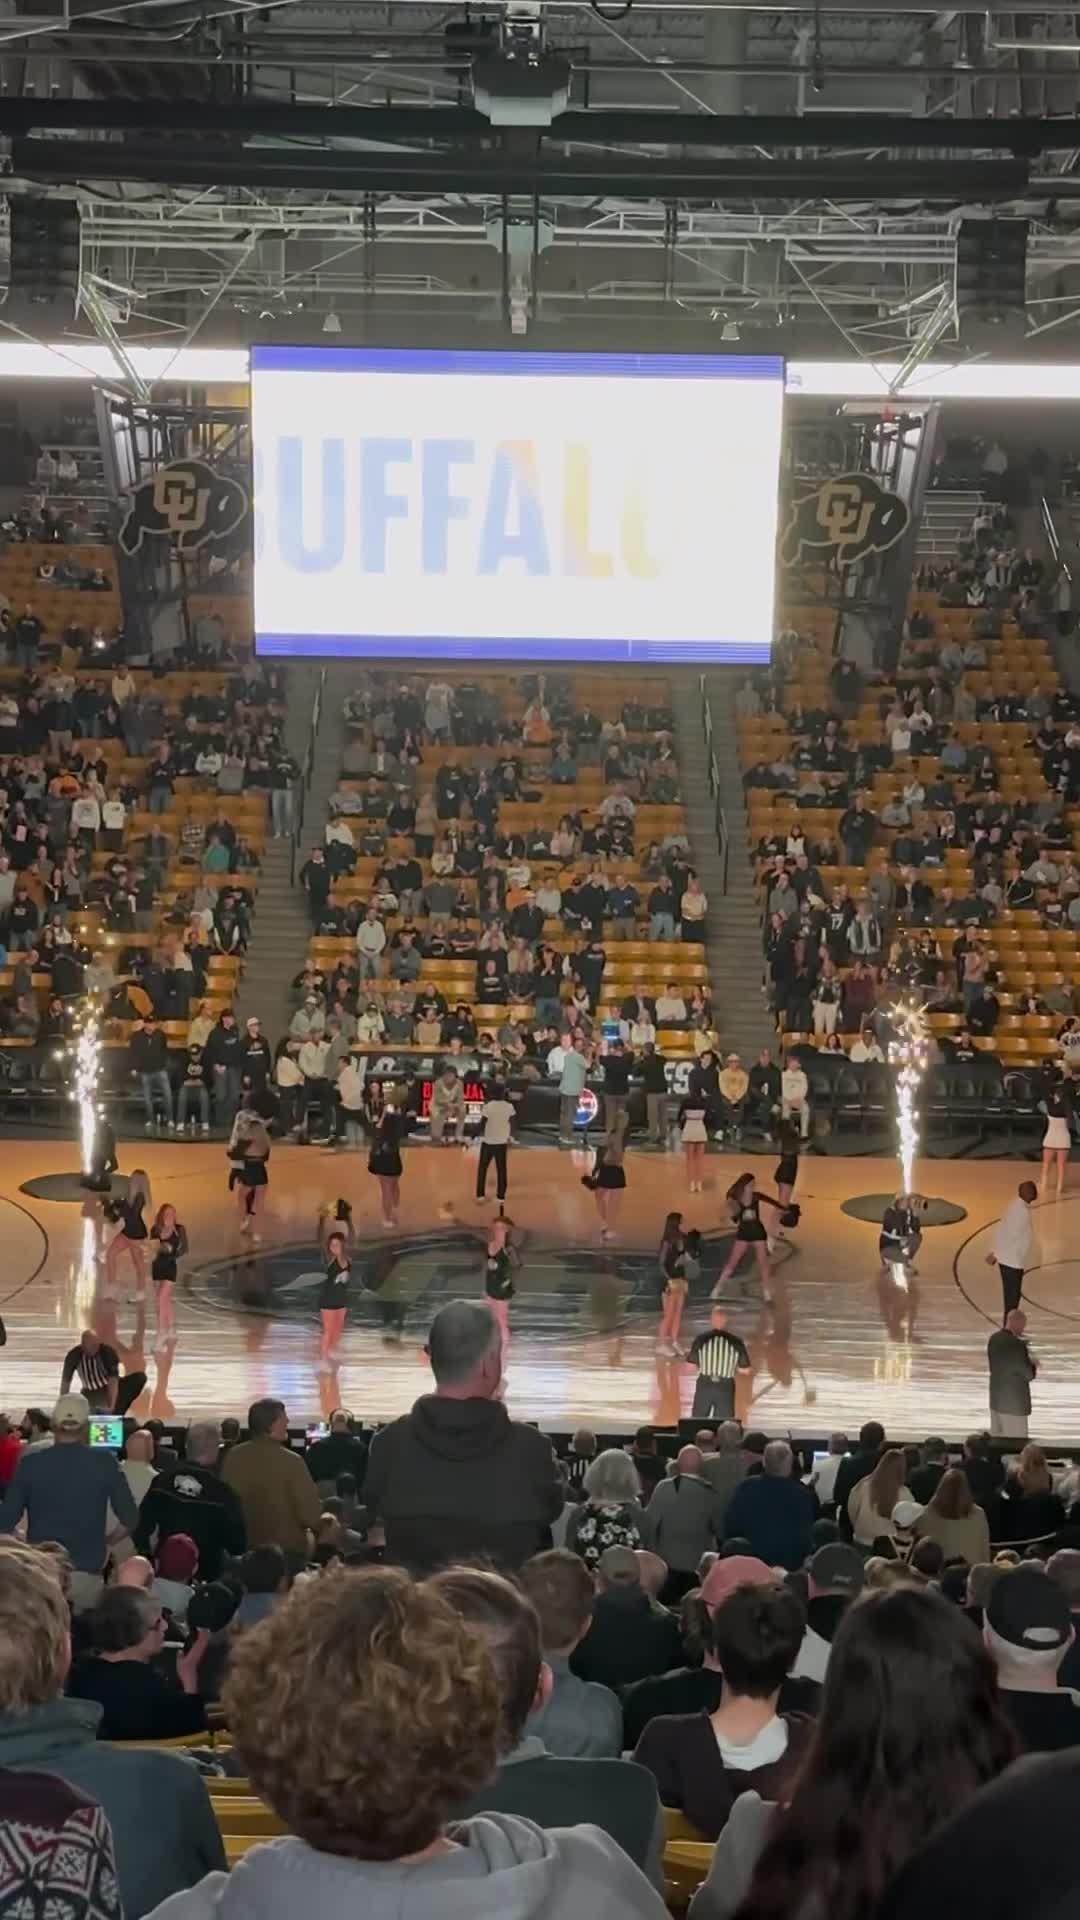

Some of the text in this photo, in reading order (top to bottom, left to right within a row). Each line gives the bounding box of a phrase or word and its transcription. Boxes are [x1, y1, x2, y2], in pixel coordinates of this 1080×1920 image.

[154, 471, 211, 530] CU
[255, 435, 665, 579] UFFAL
[816, 483, 876, 545] CU
